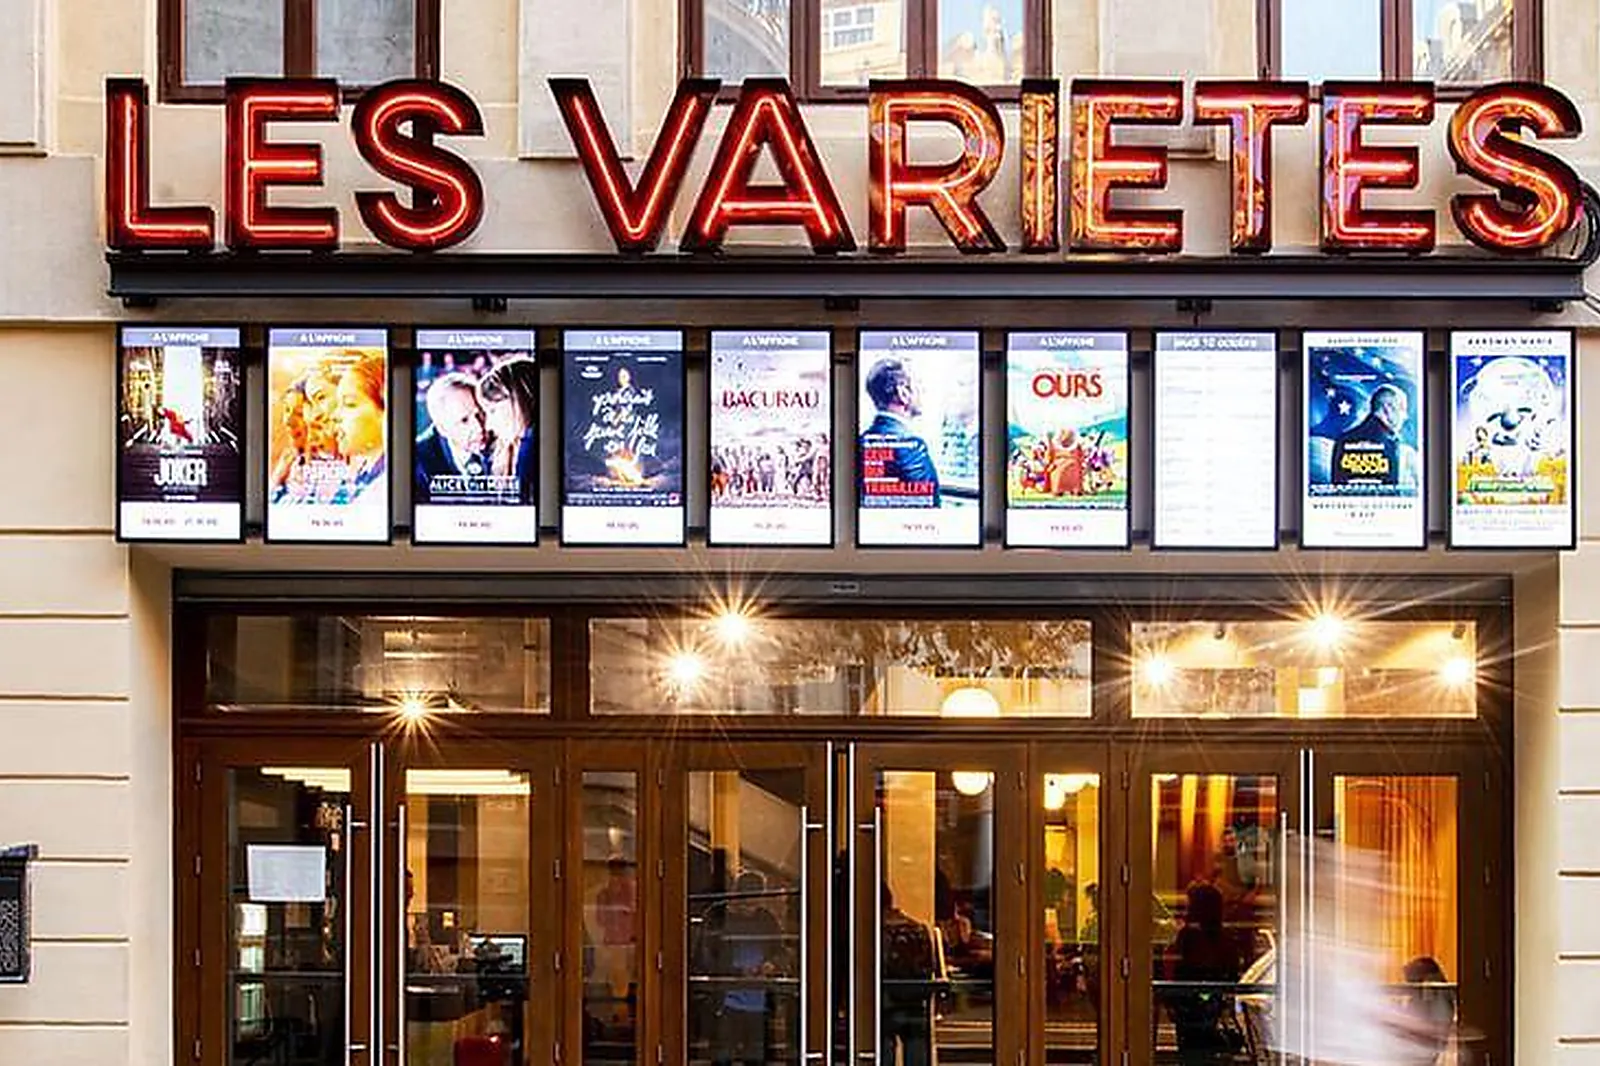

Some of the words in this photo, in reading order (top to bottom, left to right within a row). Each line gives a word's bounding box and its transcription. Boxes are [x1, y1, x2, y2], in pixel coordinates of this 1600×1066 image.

[105, 77, 484, 251] LES
[548, 77, 1583, 252] VARIETES
[722, 390, 819, 408] BACURAU
[1032, 374, 1103, 398] OURS
[154, 457, 208, 487] JOKER
